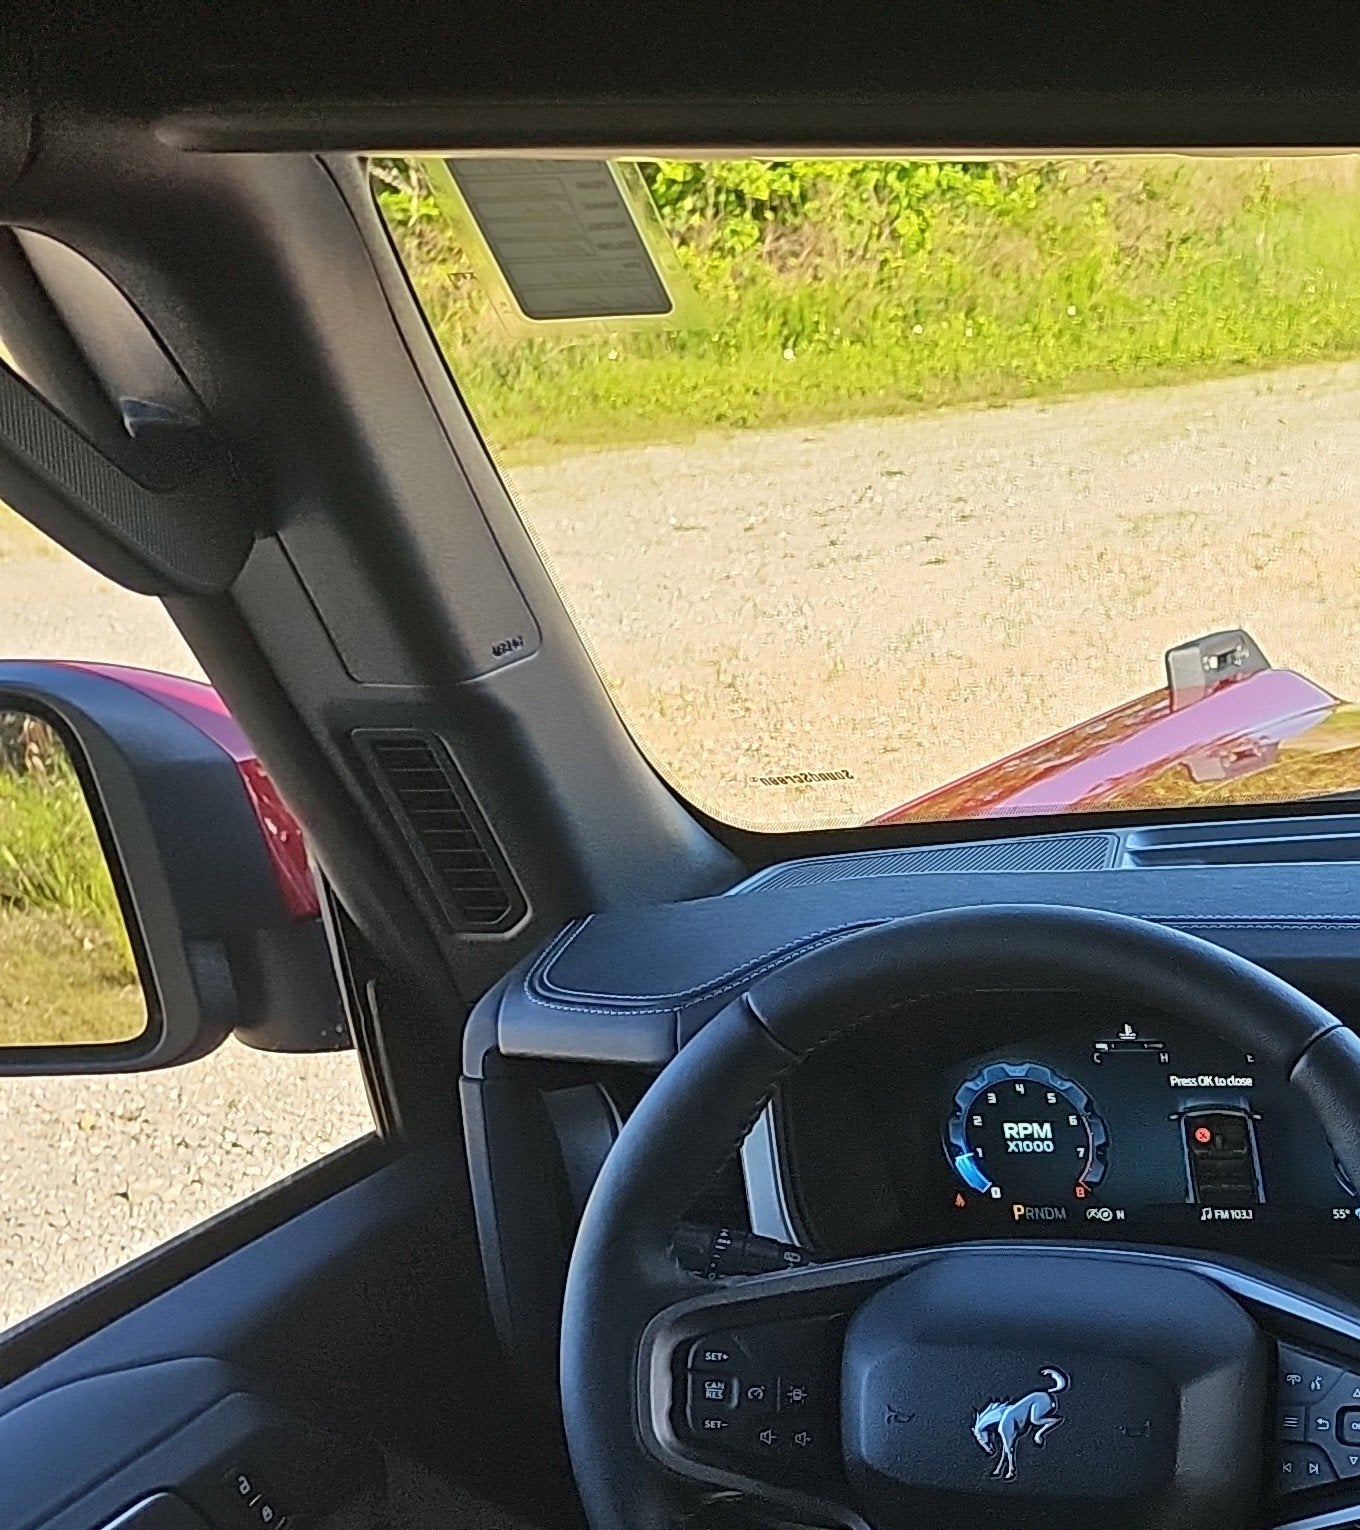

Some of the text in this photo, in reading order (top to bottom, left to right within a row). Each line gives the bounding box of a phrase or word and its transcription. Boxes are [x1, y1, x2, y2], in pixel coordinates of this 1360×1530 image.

[1169, 1075, 1253, 1087] Press OK to close
[1015, 1083, 1025, 1095] 4
[986, 1092, 997, 1104] 3
[1046, 1092, 1057, 1104] 5
[972, 1115, 983, 1127] 2
[1068, 1115, 1078, 1126] 6
[1002, 1122, 1053, 1139] RPM
[975, 1147, 984, 1158] 1
[1007, 1140, 1055, 1153] X1000
[1076, 1147, 1085, 1158] 7
[990, 1186, 1002, 1199] 0
[1214, 1209, 1229, 1220] FM
[704, 1381, 725, 1390] CAN
